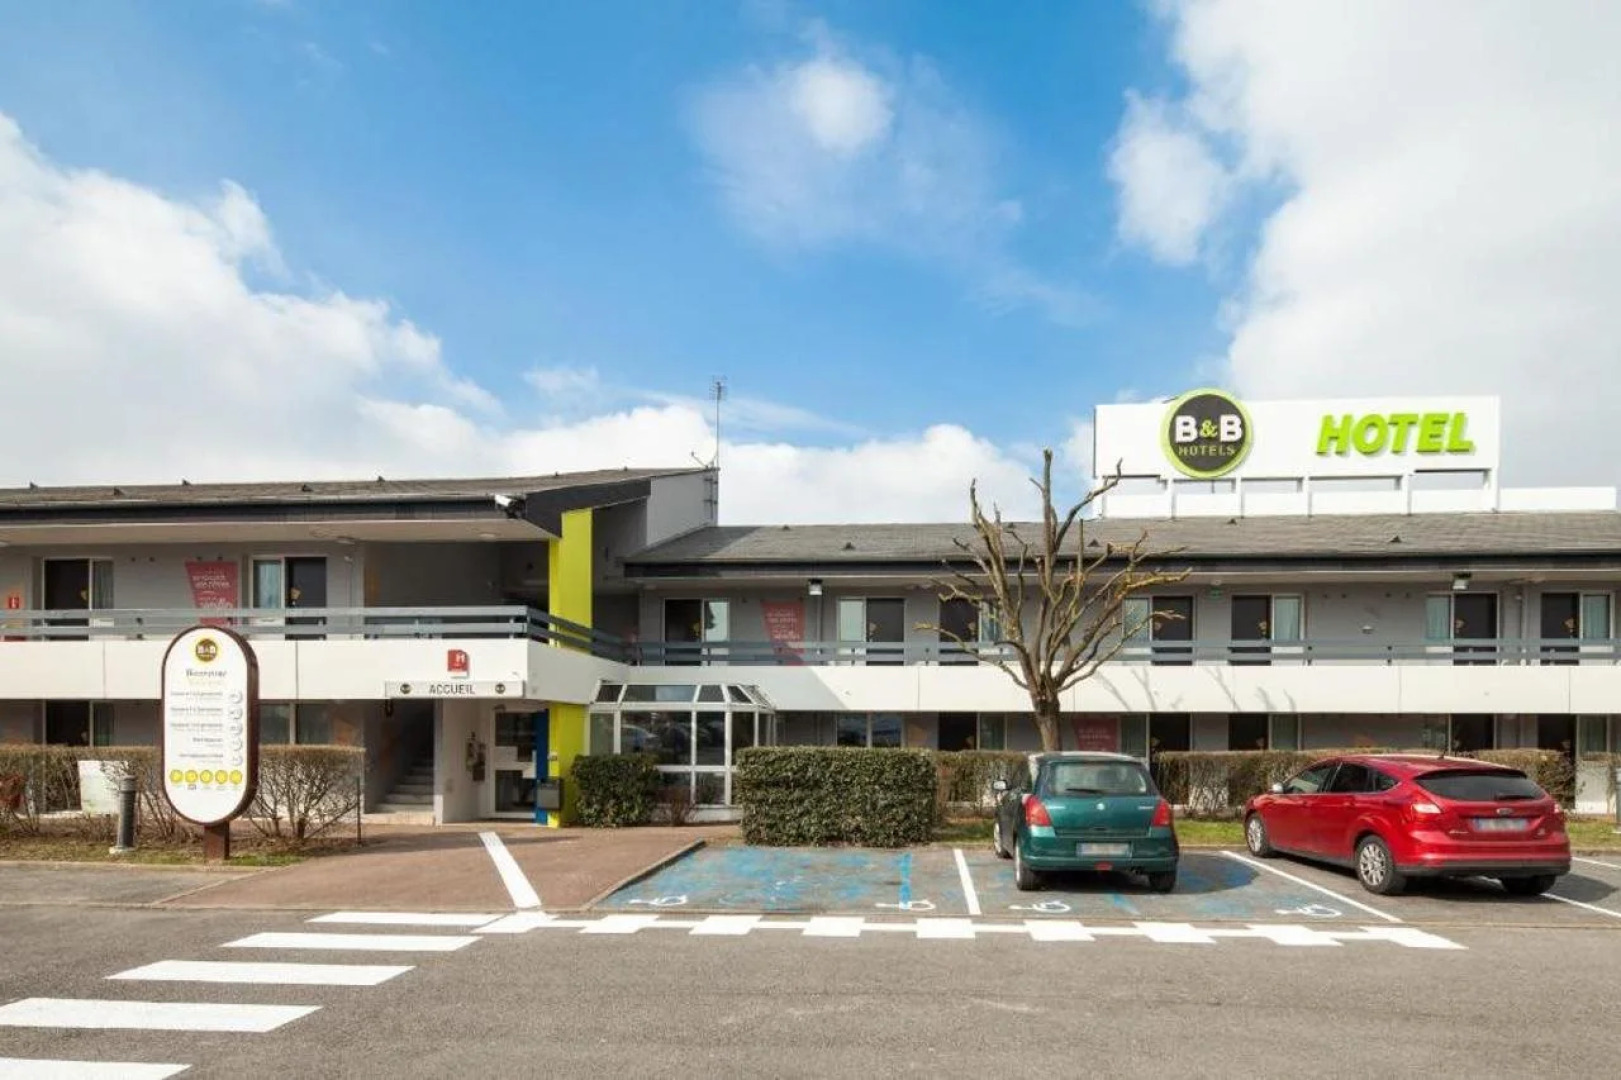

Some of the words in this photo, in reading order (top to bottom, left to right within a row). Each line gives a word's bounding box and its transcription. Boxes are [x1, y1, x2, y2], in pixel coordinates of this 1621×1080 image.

[1174, 414, 1243, 443] B&B
[1316, 411, 1477, 456] HOTEL
[1178, 445, 1236, 457] HOTELS
[429, 684, 476, 695] ACCUEIL
